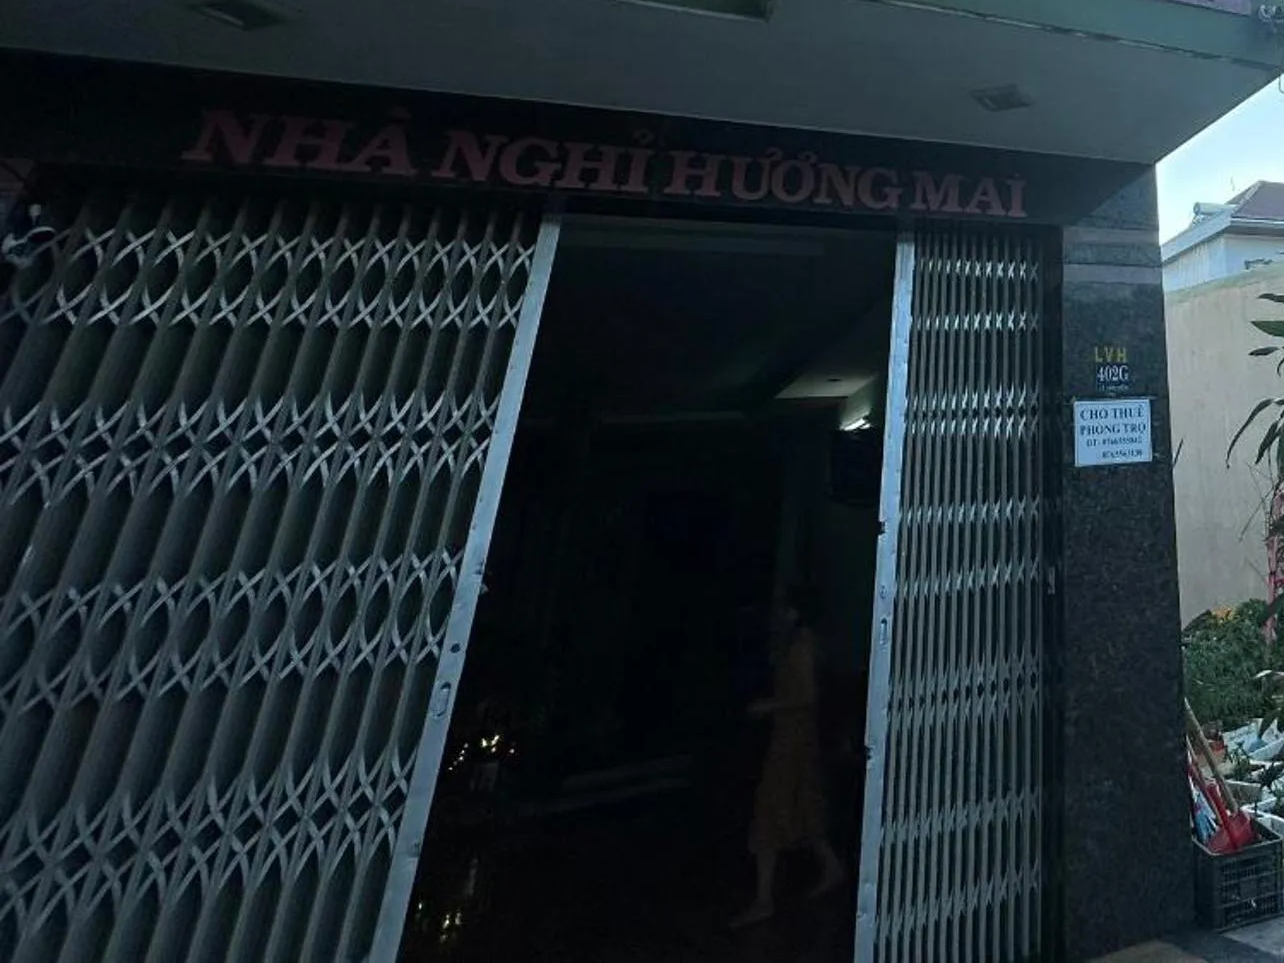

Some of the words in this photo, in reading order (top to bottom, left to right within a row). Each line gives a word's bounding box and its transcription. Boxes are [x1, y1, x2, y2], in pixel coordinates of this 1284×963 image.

[431, 128, 657, 194] NGHỈ
[1094, 346, 1128, 363] LVH
[1097, 365, 1129, 382] 402G
[1080, 408, 1109, 422] CHO
[1079, 422, 1121, 436] PHÒNG
[1122, 422, 1146, 435] TRỌ
